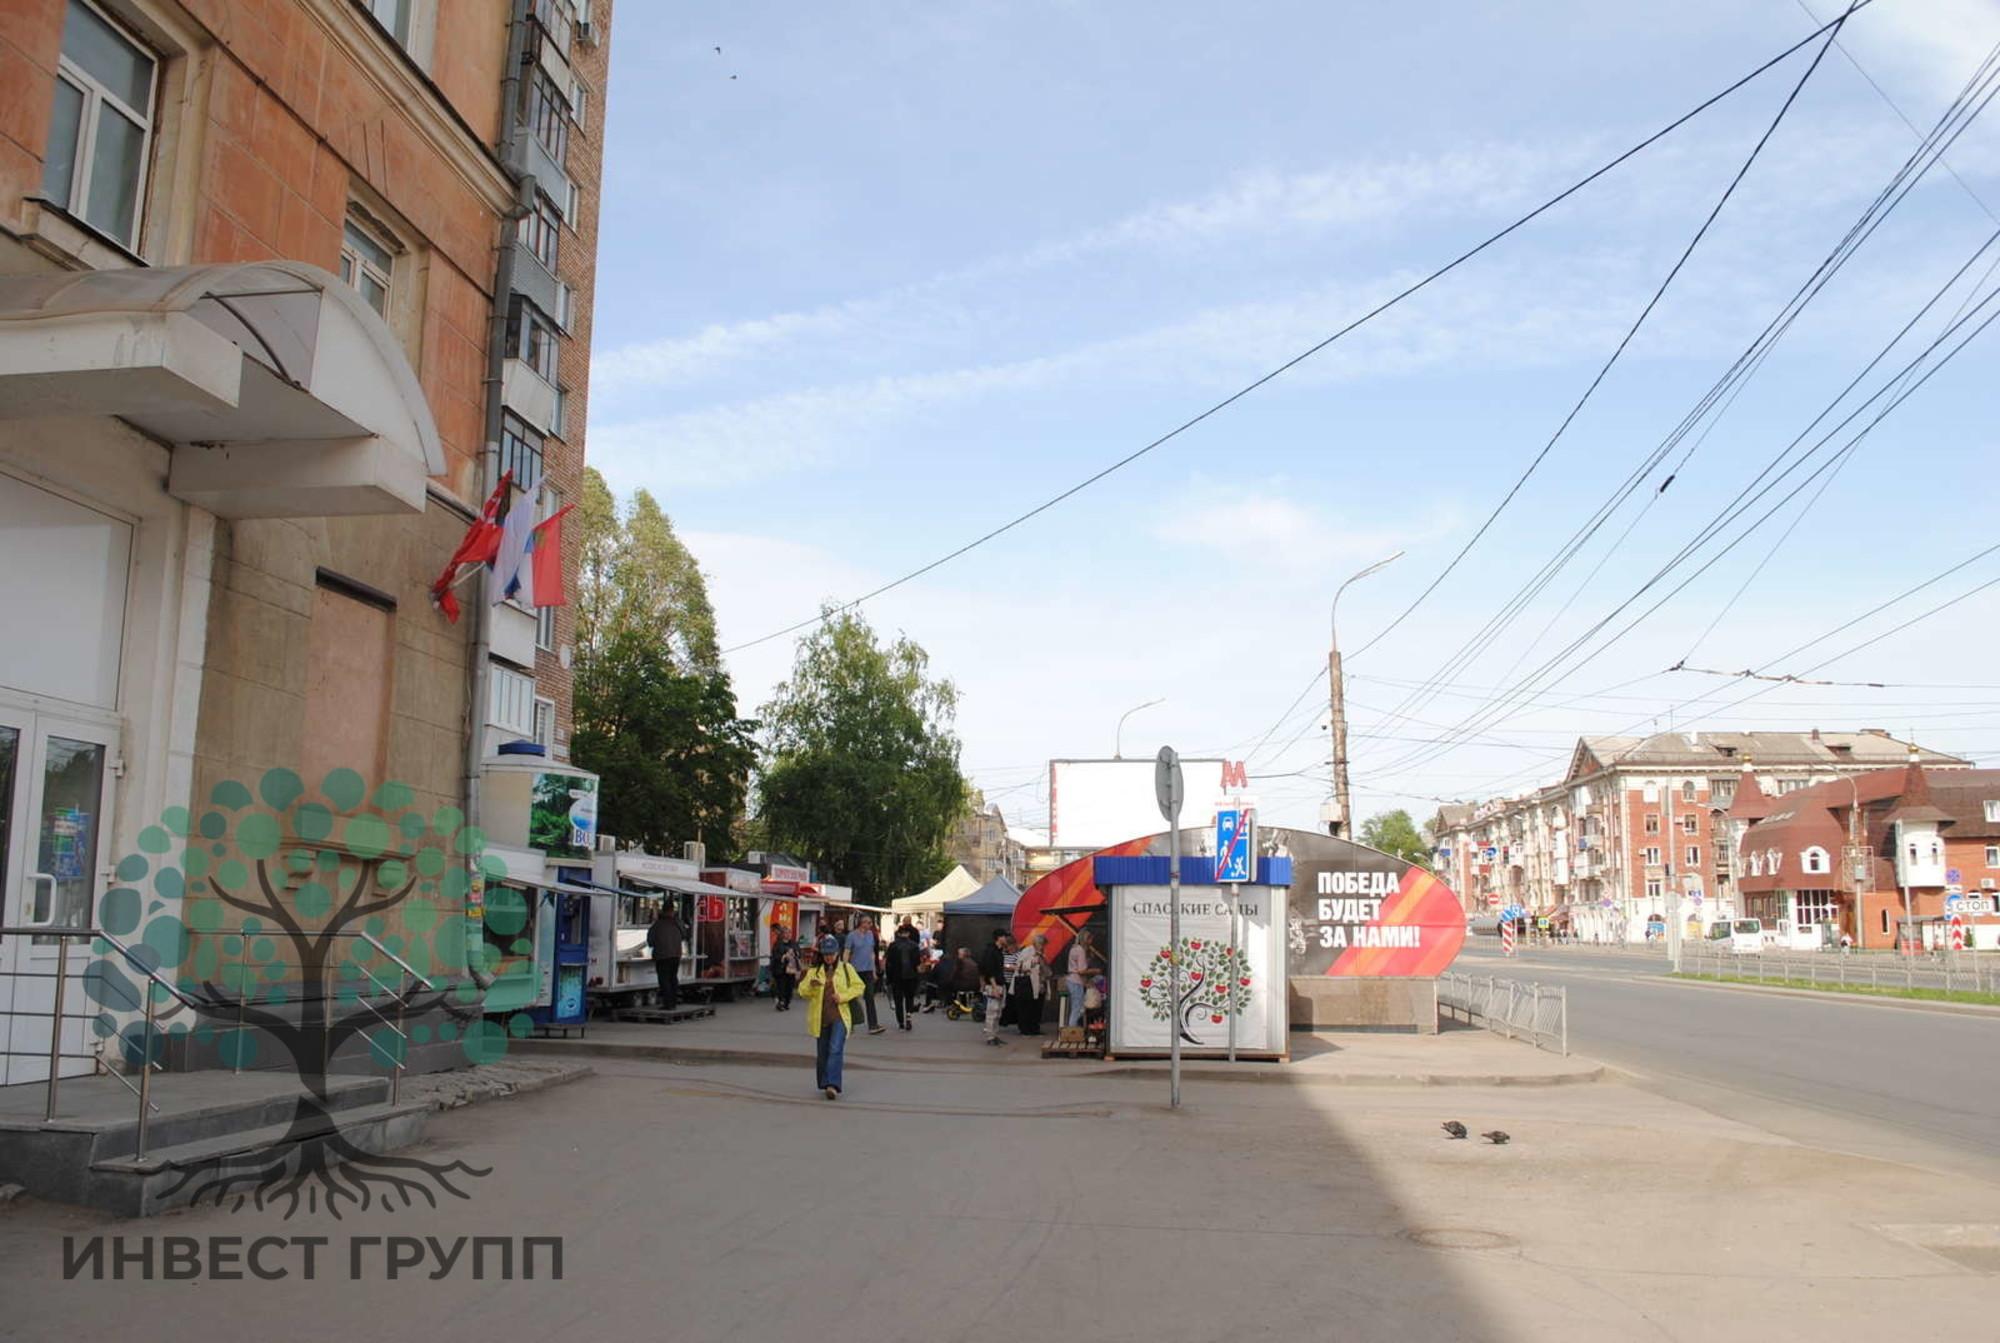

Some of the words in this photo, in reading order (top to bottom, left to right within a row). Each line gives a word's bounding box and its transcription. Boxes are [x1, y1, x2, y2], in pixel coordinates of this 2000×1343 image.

[1220, 760, 1248, 788] М
[1318, 872, 1400, 897] ПОБЕДА
[1132, 902, 1211, 916] СПАСКИЕ
[1319, 899, 1381, 924] БУДЕТ
[1956, 901, 1990, 911] СТОП
[1320, 926, 1347, 948] ЗА
[1352, 926, 1421, 948] НАМИ!
